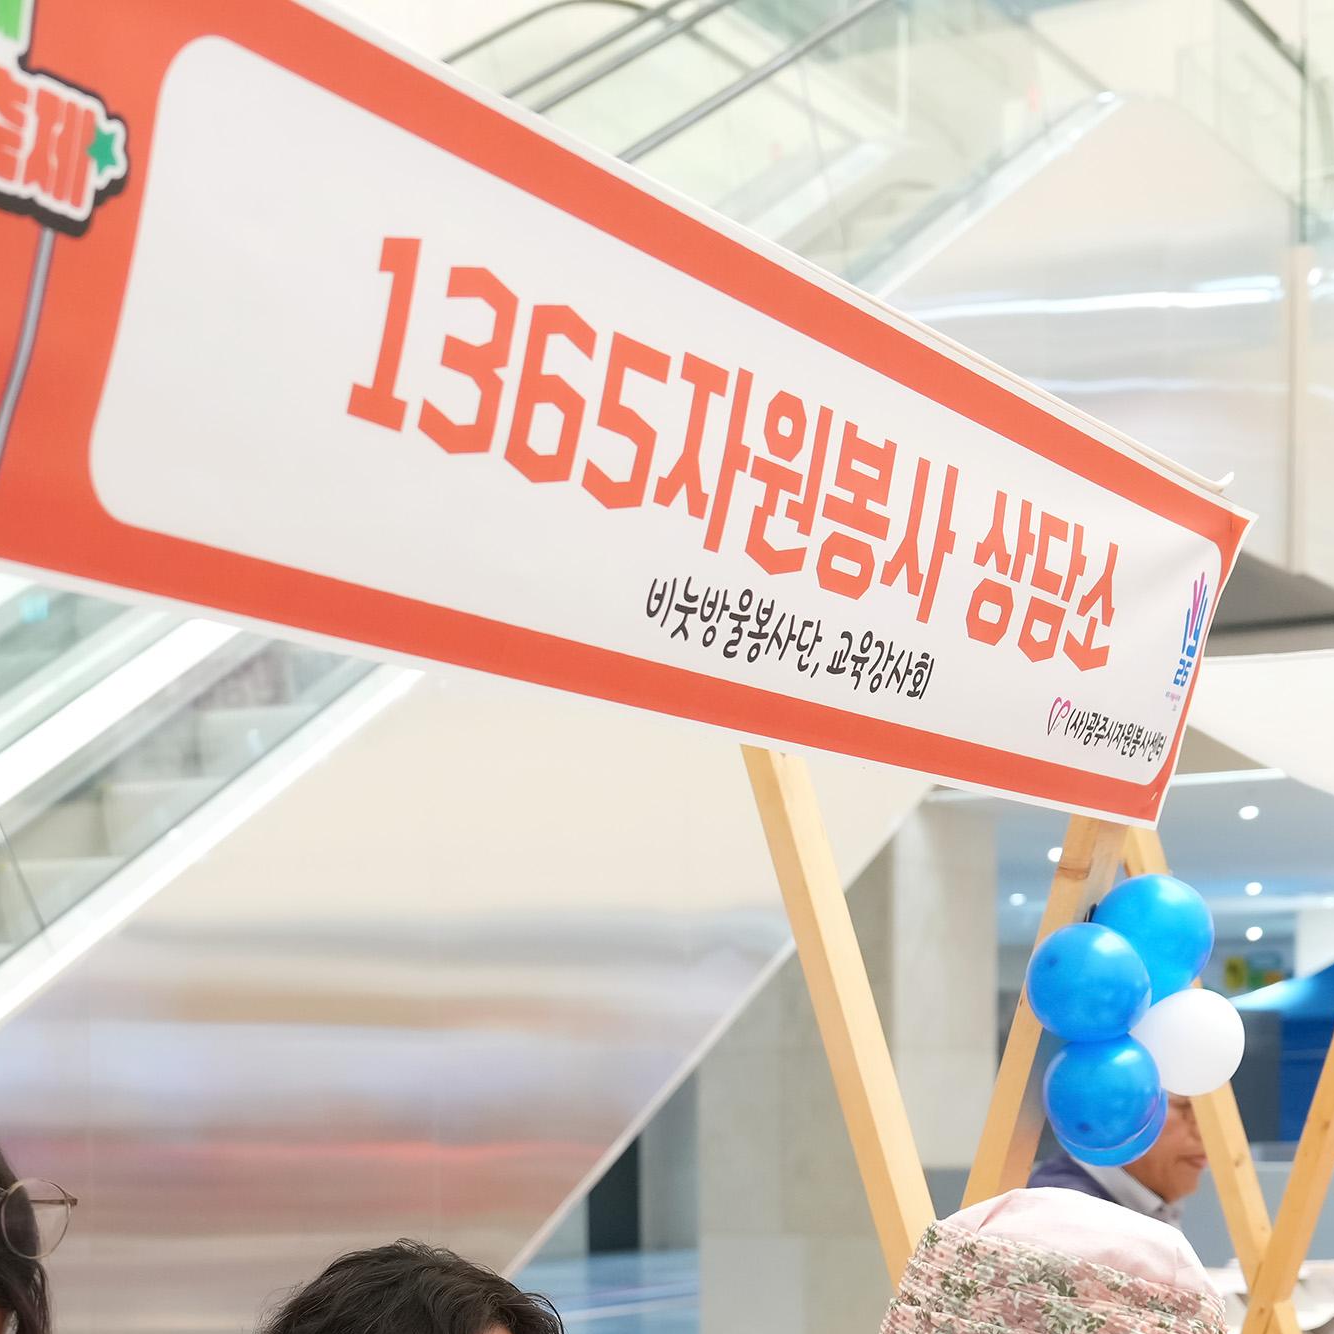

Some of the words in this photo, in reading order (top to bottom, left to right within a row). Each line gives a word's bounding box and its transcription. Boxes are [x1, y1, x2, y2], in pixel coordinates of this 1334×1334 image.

[347, 237, 958, 624] 1365자원봉사
[966, 489, 1118, 671] 상담소
[645, 574, 822, 677] 비눗방울봉사단,
[825, 630, 935, 701] 교육강사회
[1064, 707, 1168, 763] (사)광주시자원봉사센터
